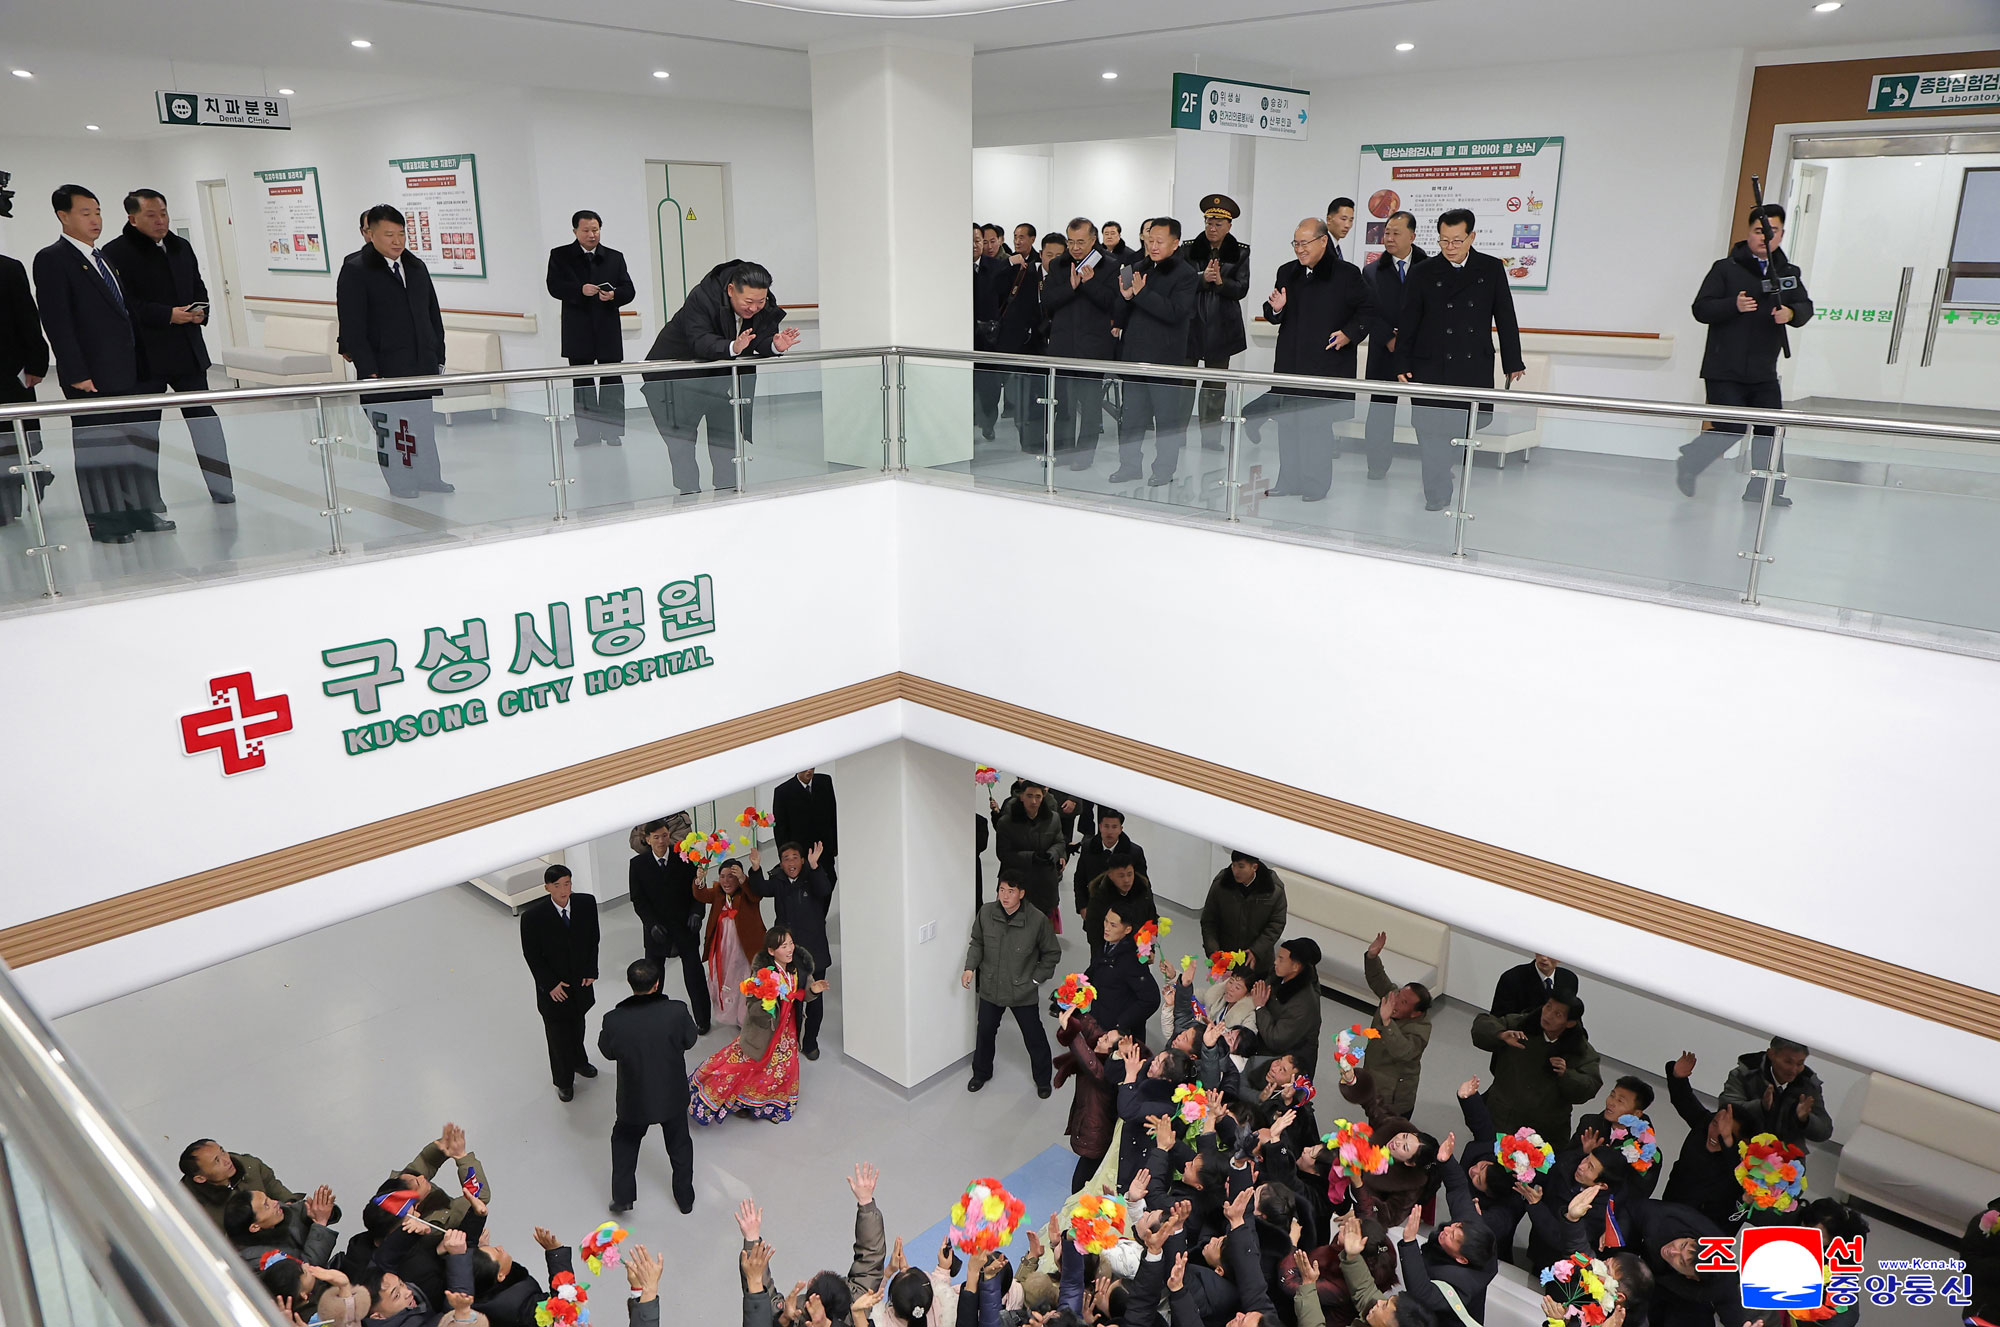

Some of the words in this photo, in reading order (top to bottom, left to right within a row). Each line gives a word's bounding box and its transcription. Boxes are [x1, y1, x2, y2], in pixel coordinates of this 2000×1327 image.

[1920, 74, 2000, 94] 종합실험검
[1181, 91, 1198, 113] 2F
[1220, 91, 1241, 104] 위생실
[1941, 94, 2000, 103] Laboratory
[204, 97, 279, 117] 치과분원
[219, 114, 245, 123] Dental
[247, 116, 270, 125] Clinic
[1445, 145, 1457, 157] 할
[1458, 144, 1469, 156] 때
[1471, 143, 1500, 156] 알아야
[1502, 143, 1513, 155] 할
[1515, 141, 1536, 154] 상식
[1814, 308, 1894, 323] 구성시병원
[321, 573, 716, 714] 구성시병원
[342, 698, 488, 756] KUSONG
[498, 676, 574, 717] CITY
[584, 645, 714, 697] HOSPITAL
